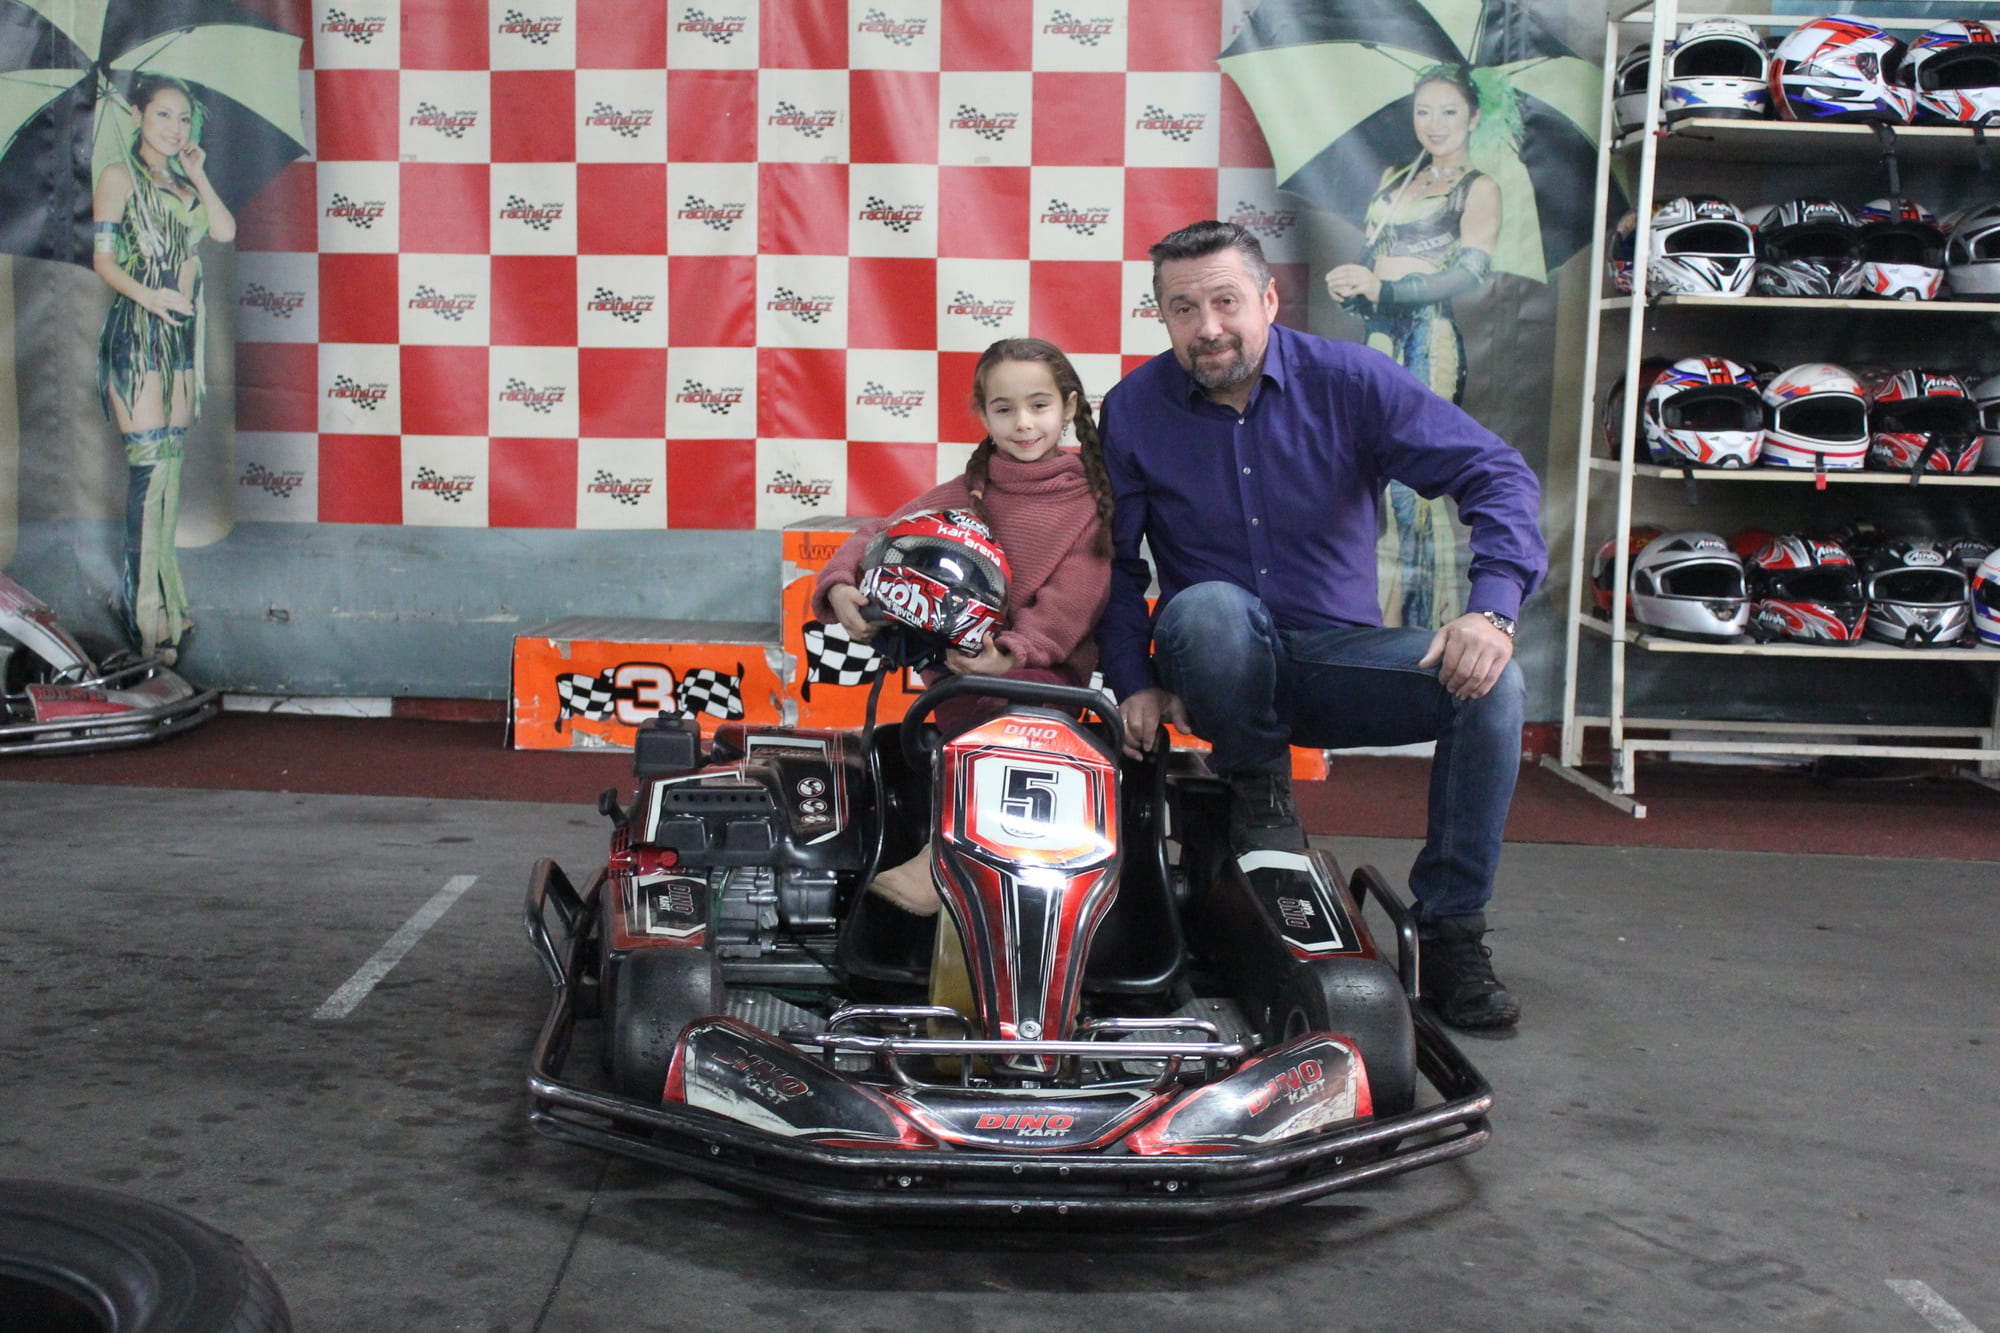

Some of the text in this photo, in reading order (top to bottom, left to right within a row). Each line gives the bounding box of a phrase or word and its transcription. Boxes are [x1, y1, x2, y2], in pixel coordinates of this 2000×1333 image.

[937, 523, 971, 540] kart
[963, 538, 1001, 567] arena
[613, 661, 677, 727] 3
[1003, 723, 1058, 740] DINO
[1000, 765, 1060, 840] 5
[667, 883, 695, 916] DINO
[1277, 896, 1311, 929] DINO
[1245, 1059, 1323, 1118] DINO
[1288, 1078, 1326, 1105] KART
[974, 1114, 1075, 1130] DINO
[1017, 1128, 1071, 1137] KART
